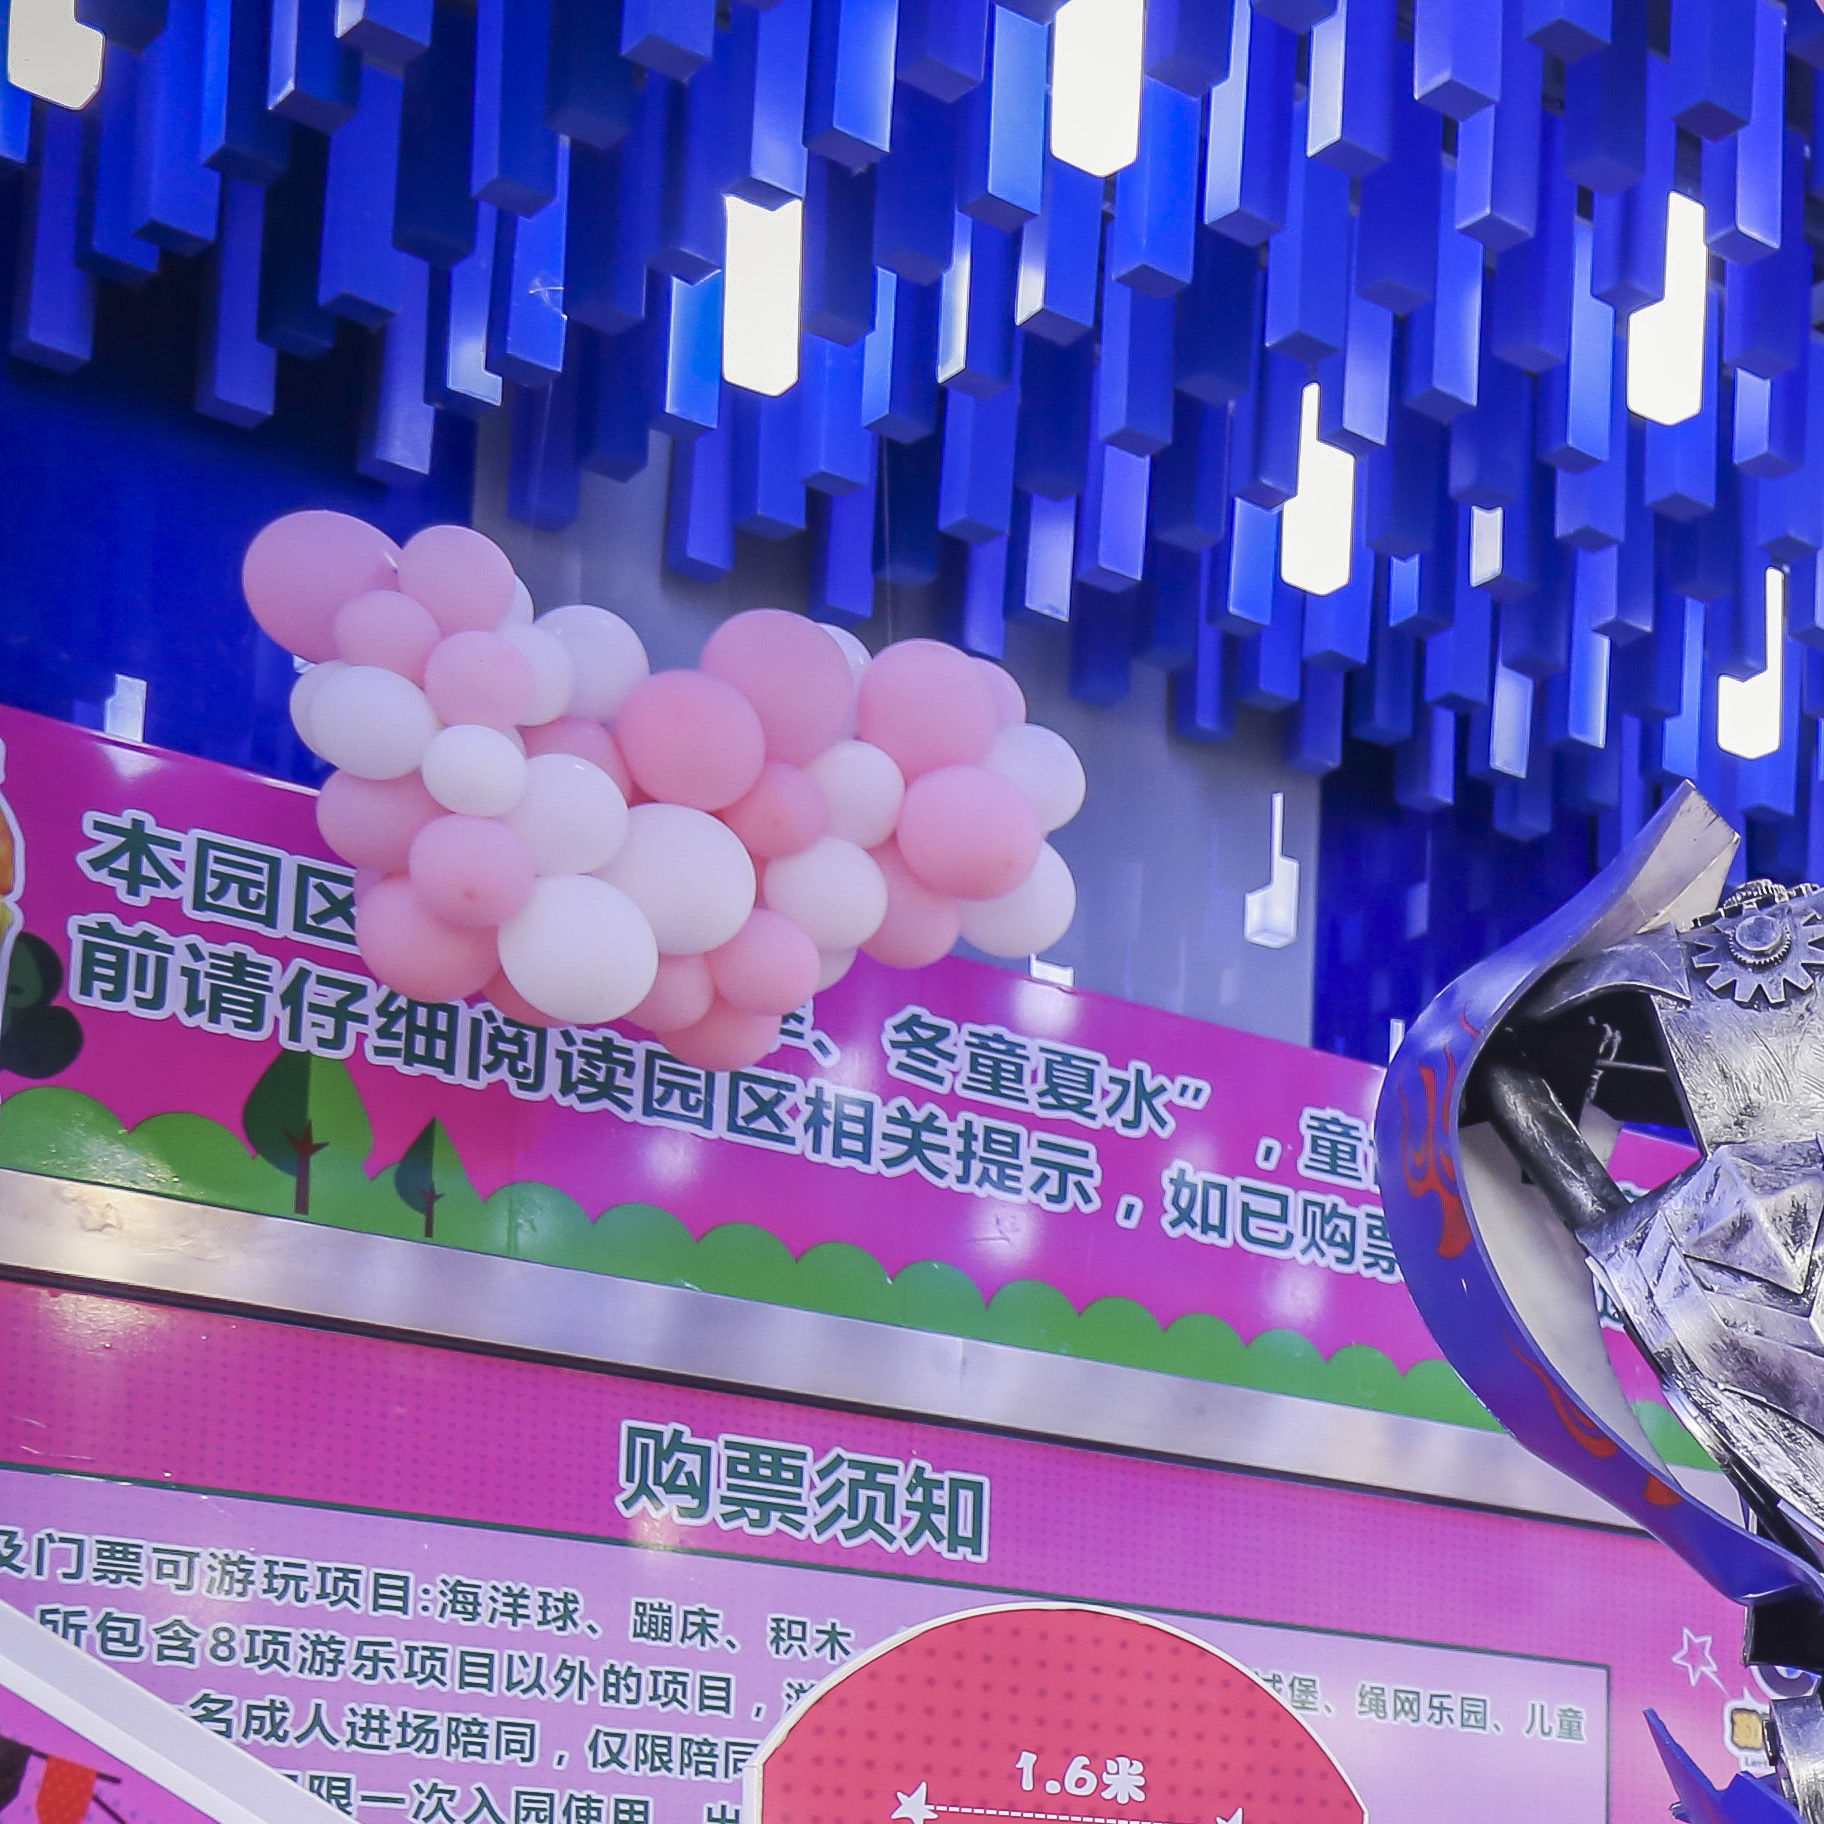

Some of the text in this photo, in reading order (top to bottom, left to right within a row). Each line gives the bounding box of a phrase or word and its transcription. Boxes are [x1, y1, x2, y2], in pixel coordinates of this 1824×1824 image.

[621, 1424, 988, 1560] 购票须知
[184, 1693, 758, 1779] 名成人进场陪同，仅限陪同
[1014, 1752, 1147, 1803] 1.6米
